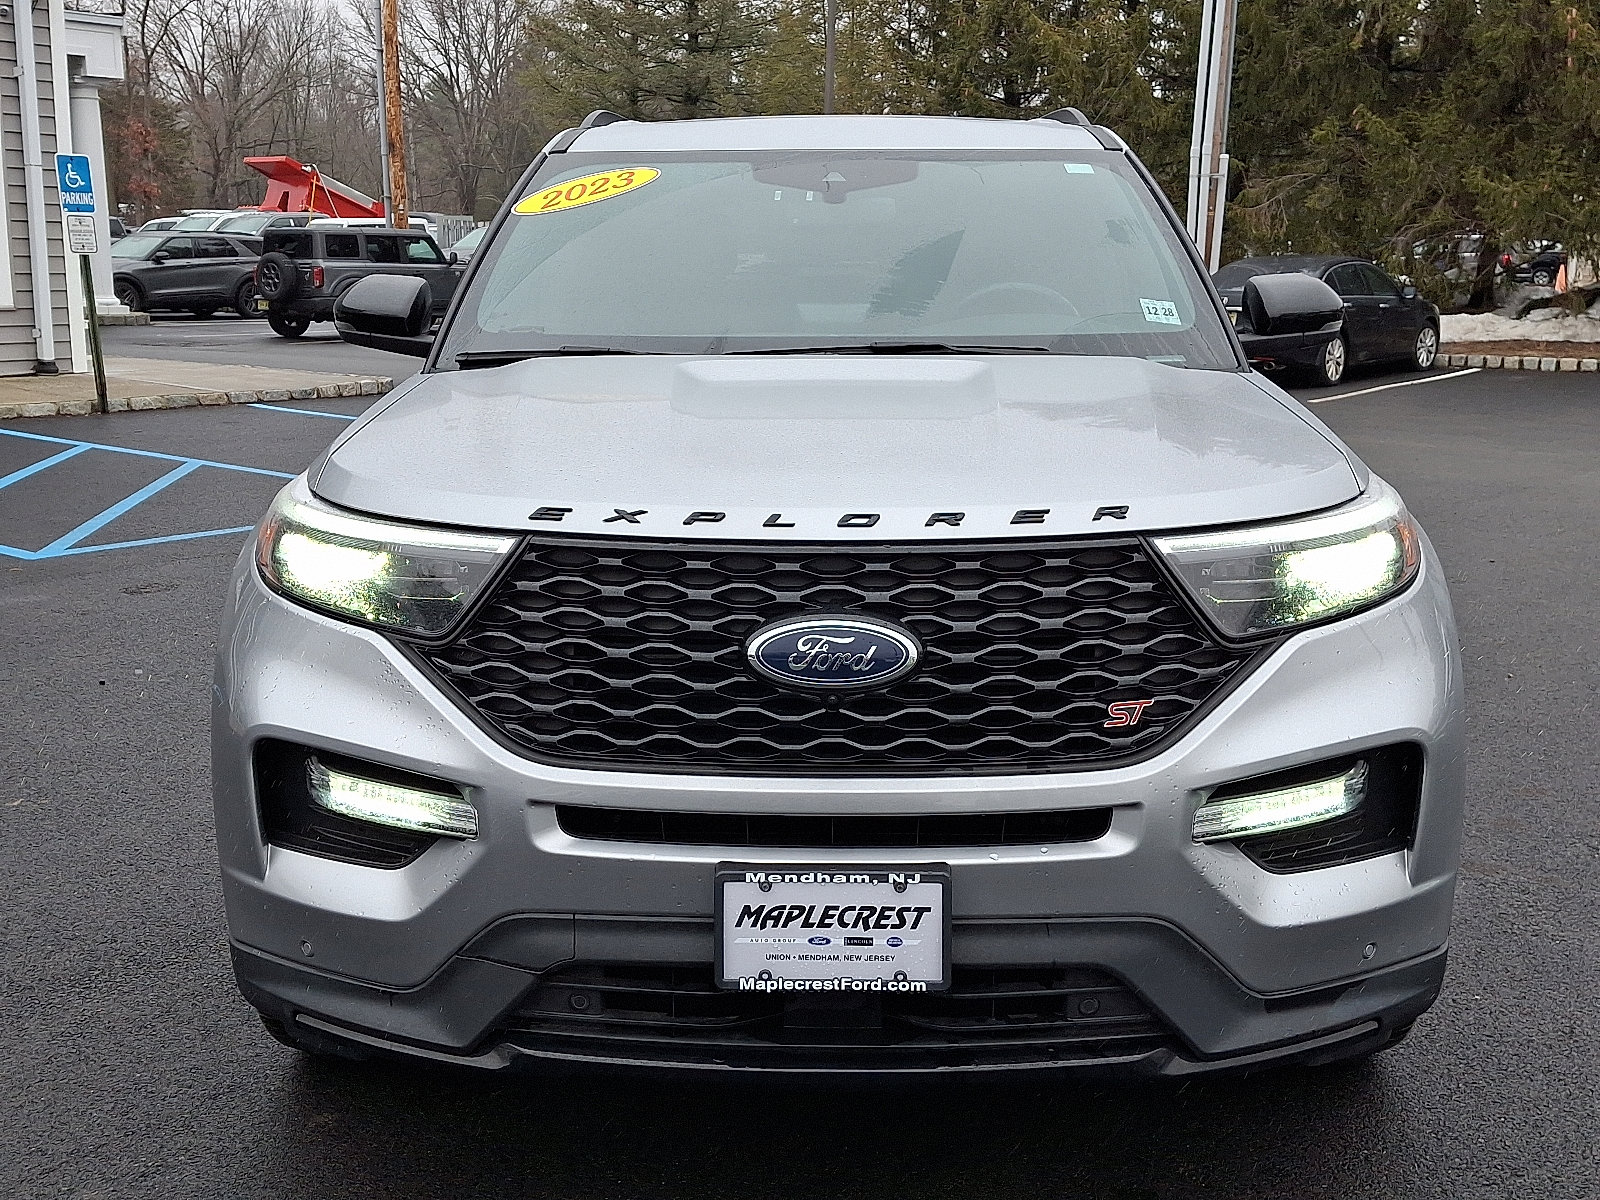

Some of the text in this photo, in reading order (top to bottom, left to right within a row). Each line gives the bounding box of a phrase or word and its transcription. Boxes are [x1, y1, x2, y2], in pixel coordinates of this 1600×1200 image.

[61, 192, 94, 204] PARKING
[541, 171, 635, 209] 2023
[1146, 306, 1174, 316] 12 28
[528, 505, 1130, 528] EXPLORER
[788, 634, 878, 671] Ford
[1103, 698, 1155, 728] ST
[745, 872, 921, 885] Mendham, NJ
[734, 904, 932, 932] MAPLECREST
[765, 953, 896, 962] UNION MENDHAM, NEW JERSEY
[739, 977, 927, 993] MaplecrestFord.com
